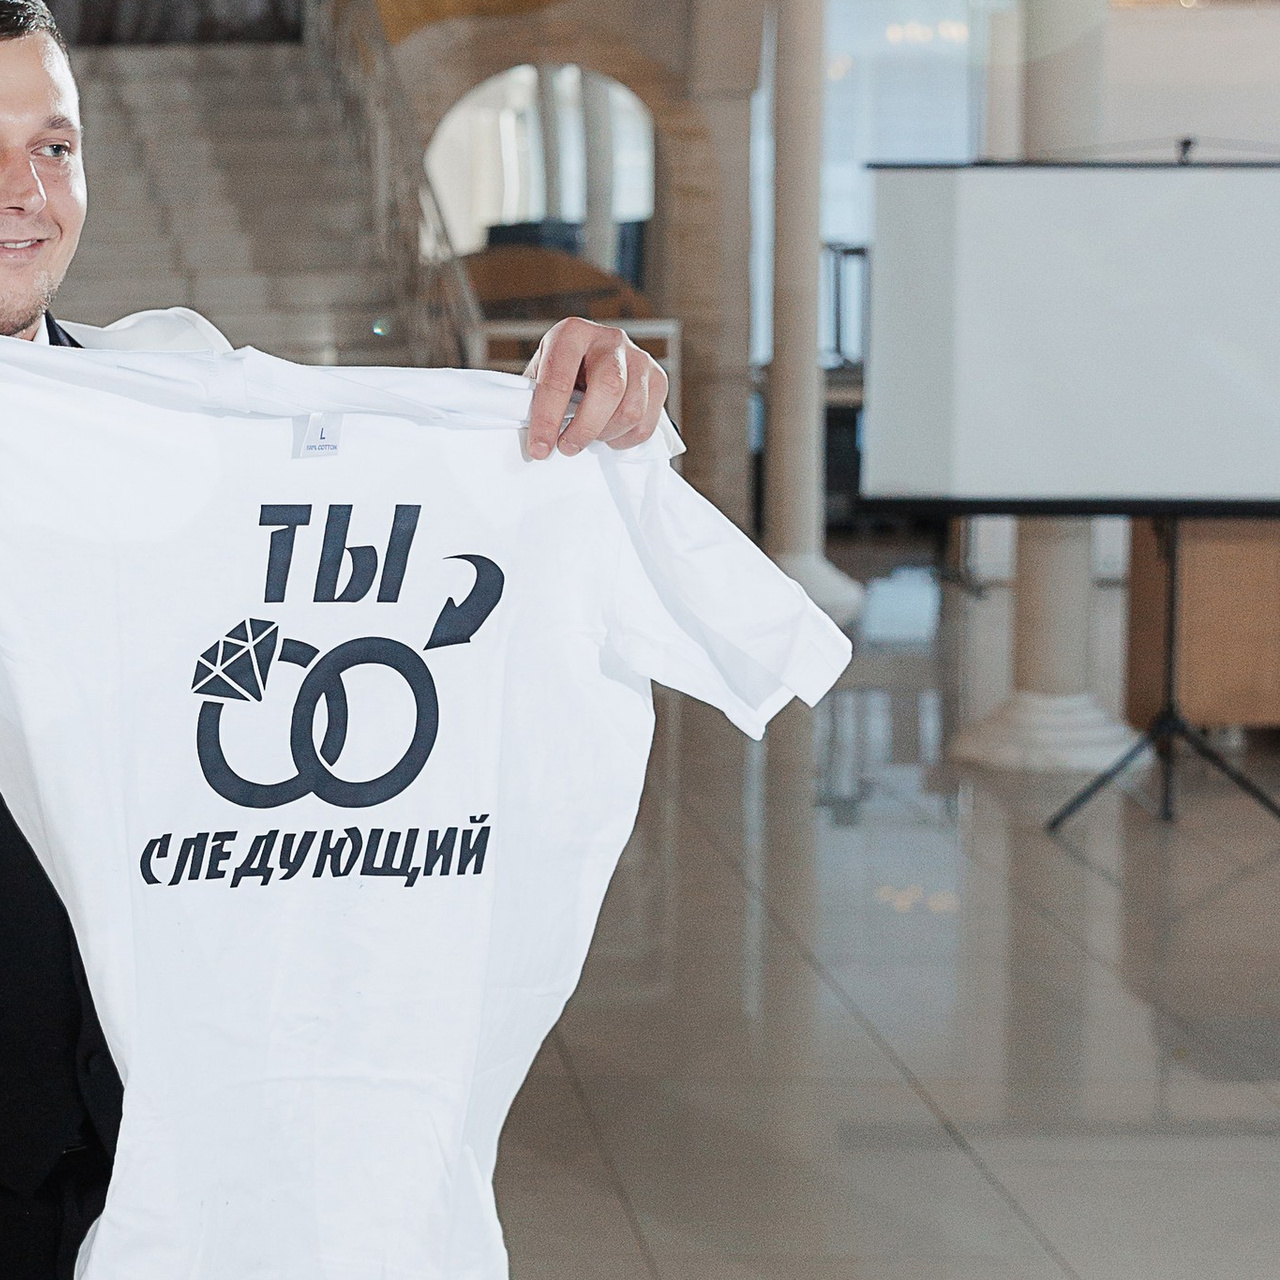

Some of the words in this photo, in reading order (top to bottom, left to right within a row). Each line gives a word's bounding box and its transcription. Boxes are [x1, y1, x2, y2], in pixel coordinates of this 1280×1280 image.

[319, 427, 326, 440] L
[258, 503, 422, 604] ТЫ
[139, 813, 491, 889] СЛЕДУЮЩИЙ
